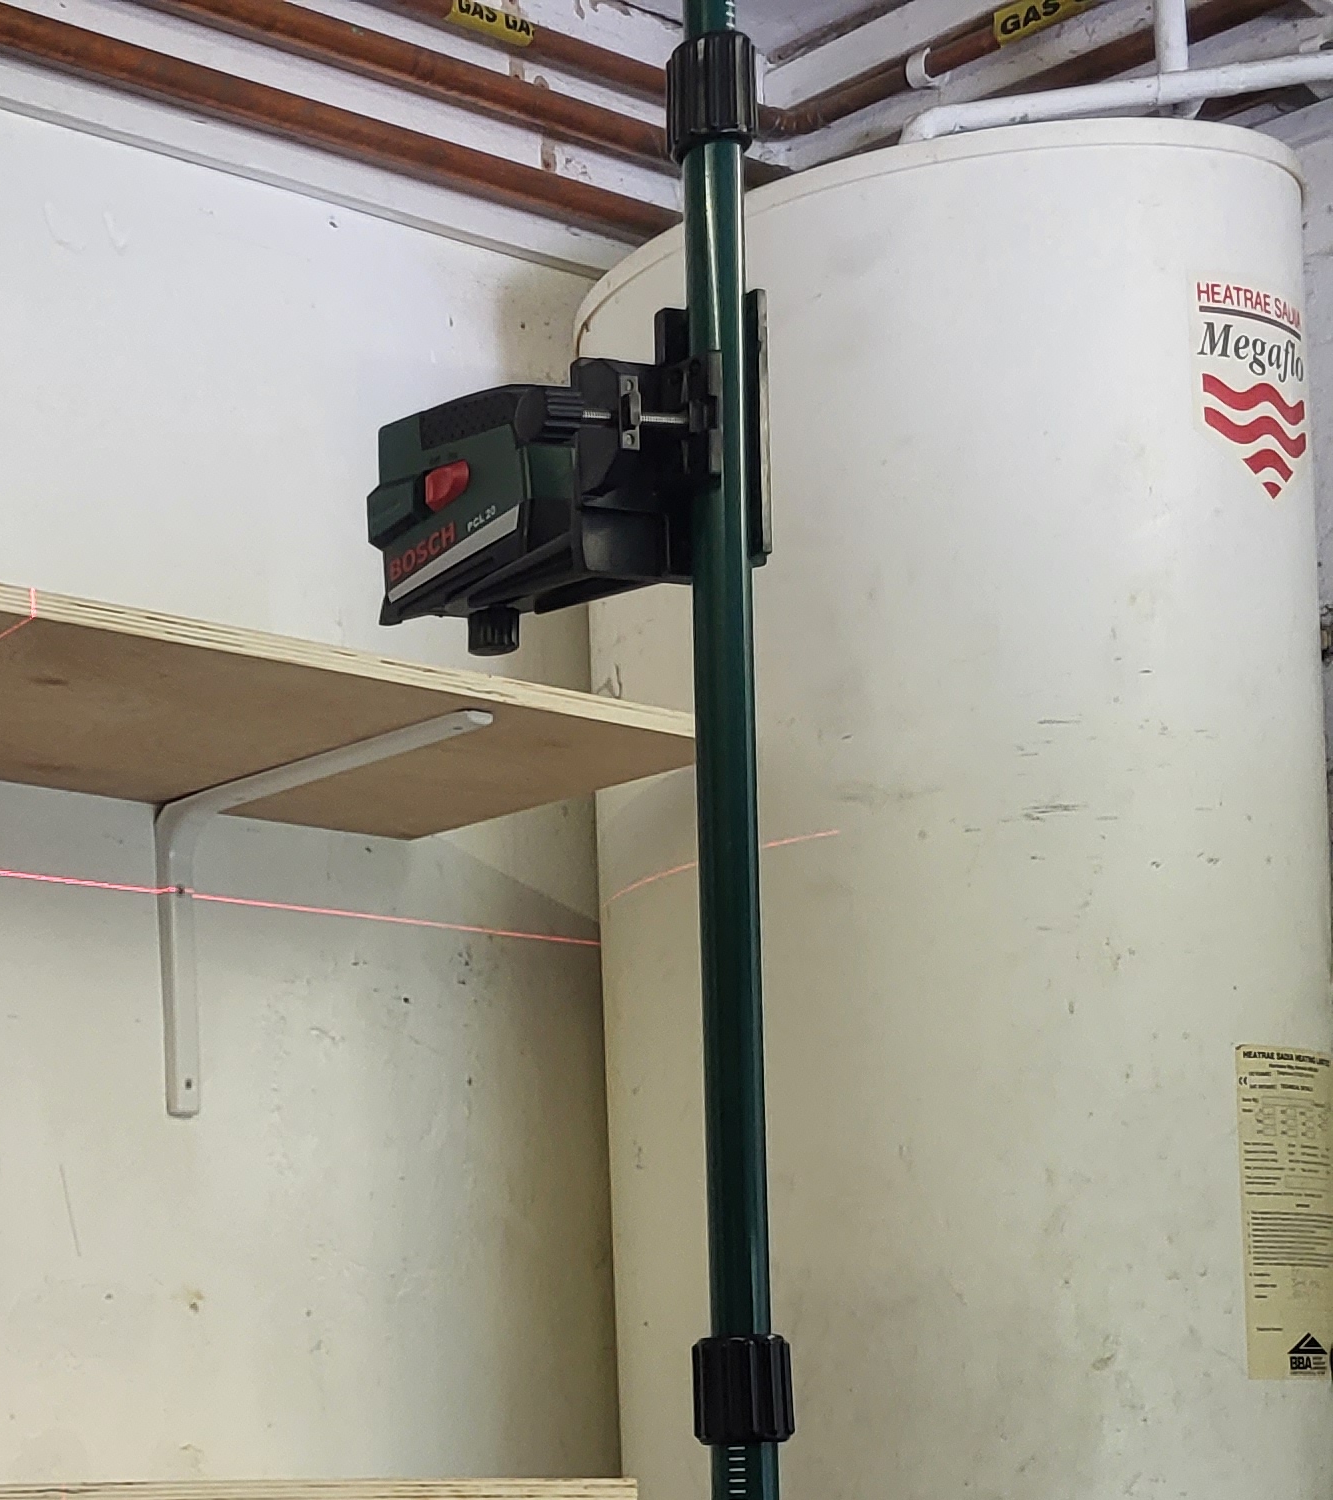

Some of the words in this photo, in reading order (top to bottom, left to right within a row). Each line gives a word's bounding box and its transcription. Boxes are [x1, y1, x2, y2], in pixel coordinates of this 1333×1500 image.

[504, 13, 535, 36] GA
[1000, 0, 1061, 35] GAS
[1196, 281, 1272, 315] HEATRAE
[1196, 321, 1304, 384] Megaflo
[390, 521, 457, 581] BOSCH
[466, 513, 485, 532] PCL
[1289, 1355, 1313, 1370] BBA
